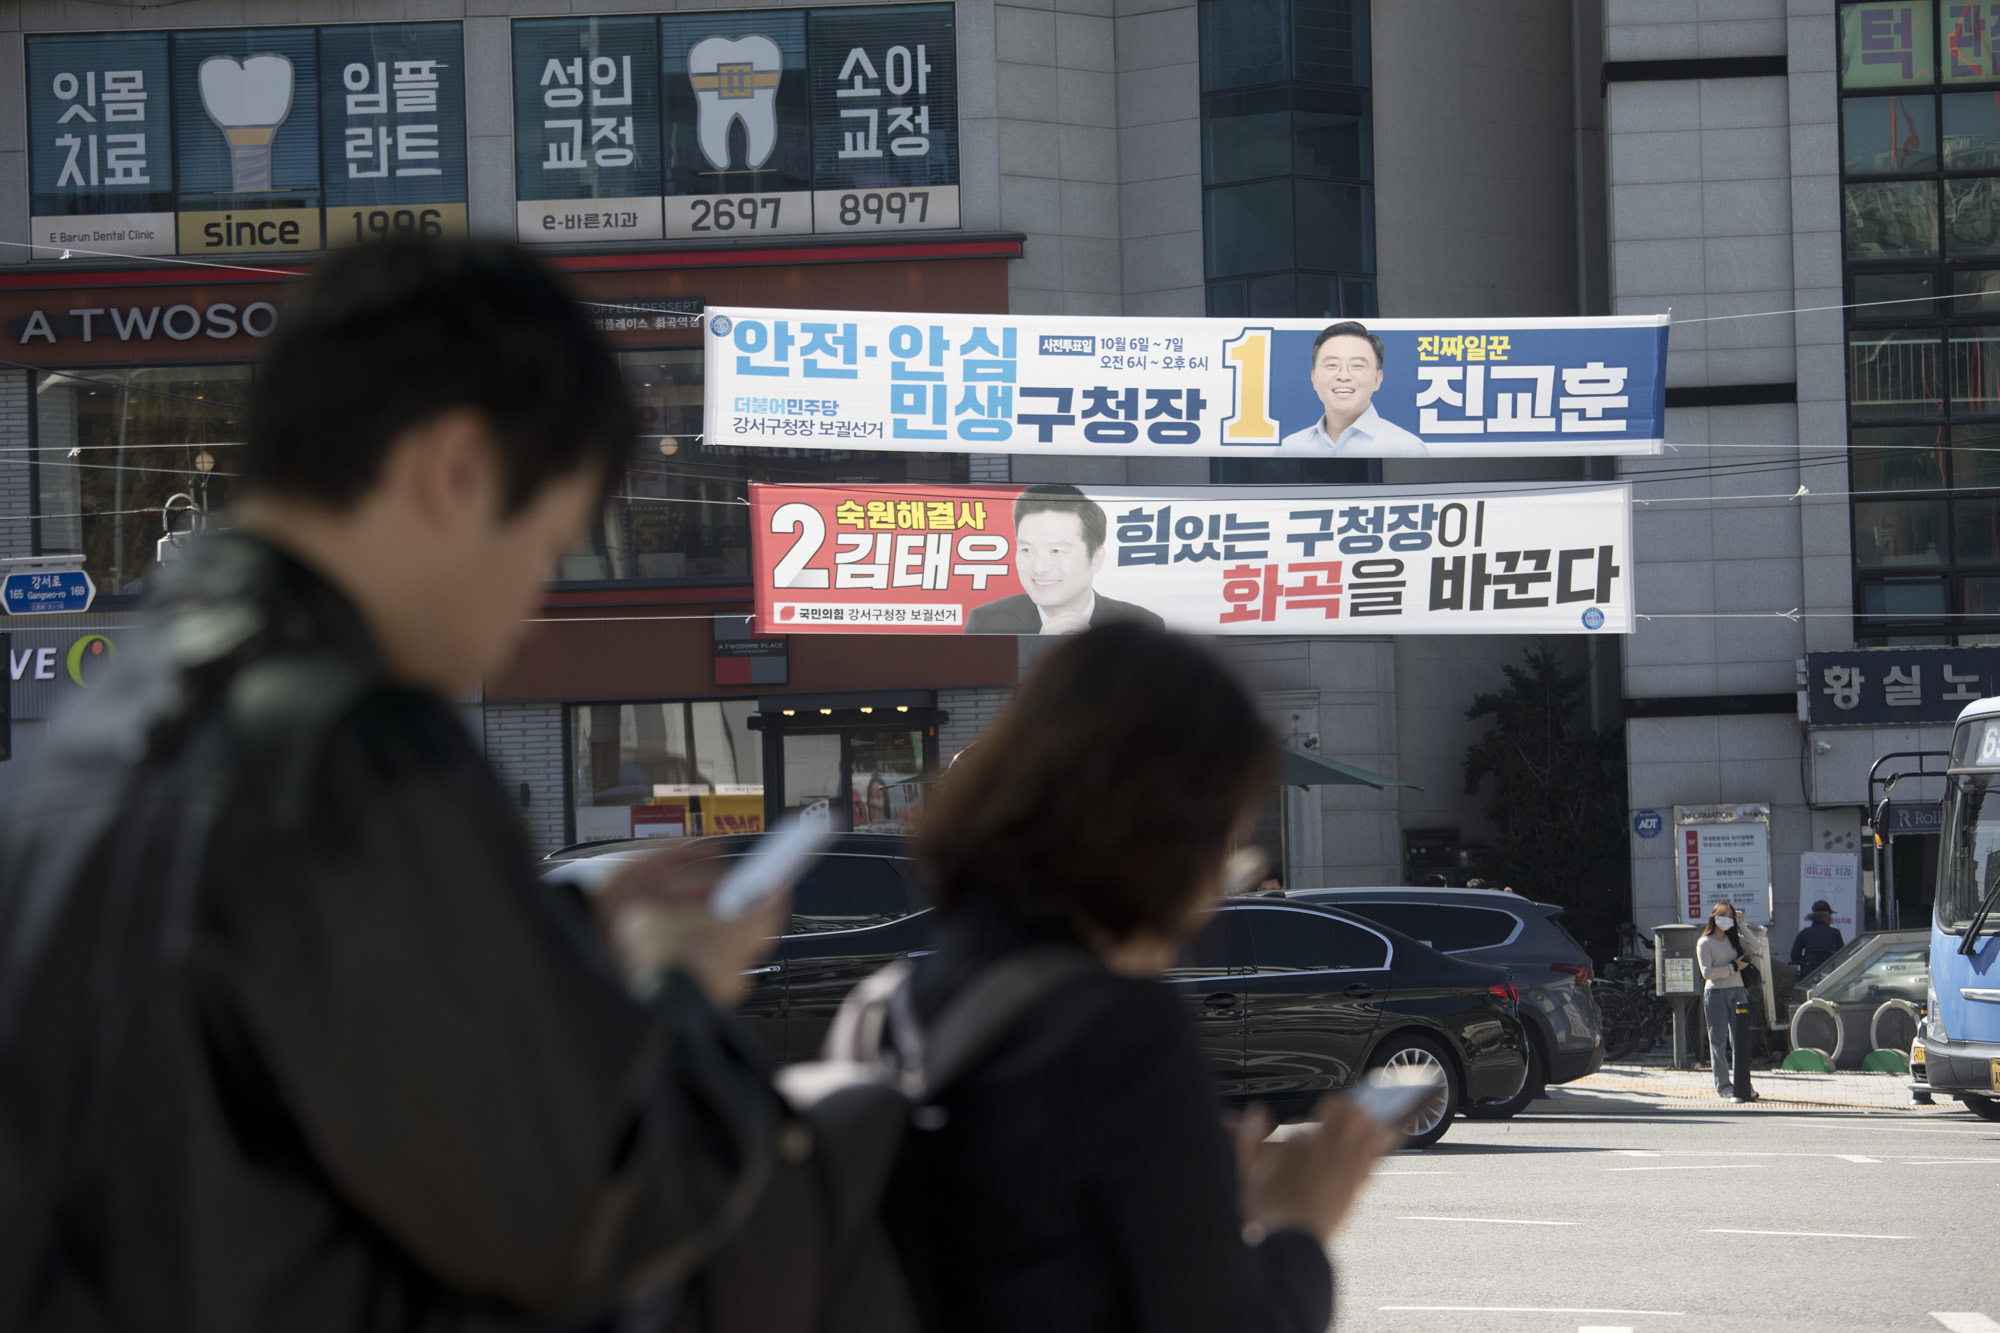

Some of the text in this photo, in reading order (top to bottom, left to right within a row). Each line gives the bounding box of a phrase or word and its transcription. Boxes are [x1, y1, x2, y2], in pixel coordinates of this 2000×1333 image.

[343, 60, 440, 115] 임플
[540, 55, 632, 108] 성인
[836, 44, 931, 98] 소아
[53, 70, 147, 124] 잇몸
[543, 116, 634, 170] 교정
[838, 105, 931, 159] 교정
[55, 133, 150, 187] 치료
[346, 125, 442, 179] 란트
[542, 212, 638, 231] e-바른치과
[691, 198, 782, 232] 2697
[839, 192, 930, 226] 8997
[50, 229, 155, 243] E Barun Dental Clinic
[204, 214, 300, 247] since
[352, 209, 442, 243] 1996
[20, 311, 56, 344] A
[1042, 339, 1092, 353] 사전투표일
[1100, 337, 1126, 352] 10월
[1129, 337, 1149, 352] 6일
[1164, 338, 1183, 352] 7일
[1417, 335, 1511, 361] 진짜일꾼
[1100, 355, 1124, 370] 오전
[1127, 356, 1147, 370] 6시
[1162, 356, 1185, 370] 오후
[1188, 356, 1208, 371] 6시
[1221, 327, 1282, 446] 1
[1416, 362, 1628, 434] 진교훈
[734, 397, 839, 416] 더불어민주당
[890, 383, 1207, 444] 민생구청장
[733, 418, 883, 439] 강서구청장 보궐선거
[836, 500, 987, 530] 숙원해결사
[771, 502, 830, 589] 2
[1117, 501, 1485, 567] 힘있는 구청장이
[834, 532, 1009, 590] 김태우
[10, 589, 24, 599] 165
[27, 592, 67, 601] Gangseo-ro
[32, 575, 62, 590] 강서로
[70, 586, 85, 596] 169
[1219, 545, 1620, 624] 화곡을 바꾼다
[799, 608, 957, 622] 국민의힘 강서구청장 보궐선거
[1982, 726, 2000, 759] 6
[1638, 818, 1658, 829] ADT
[1682, 811, 1733, 819] INFORMATION
